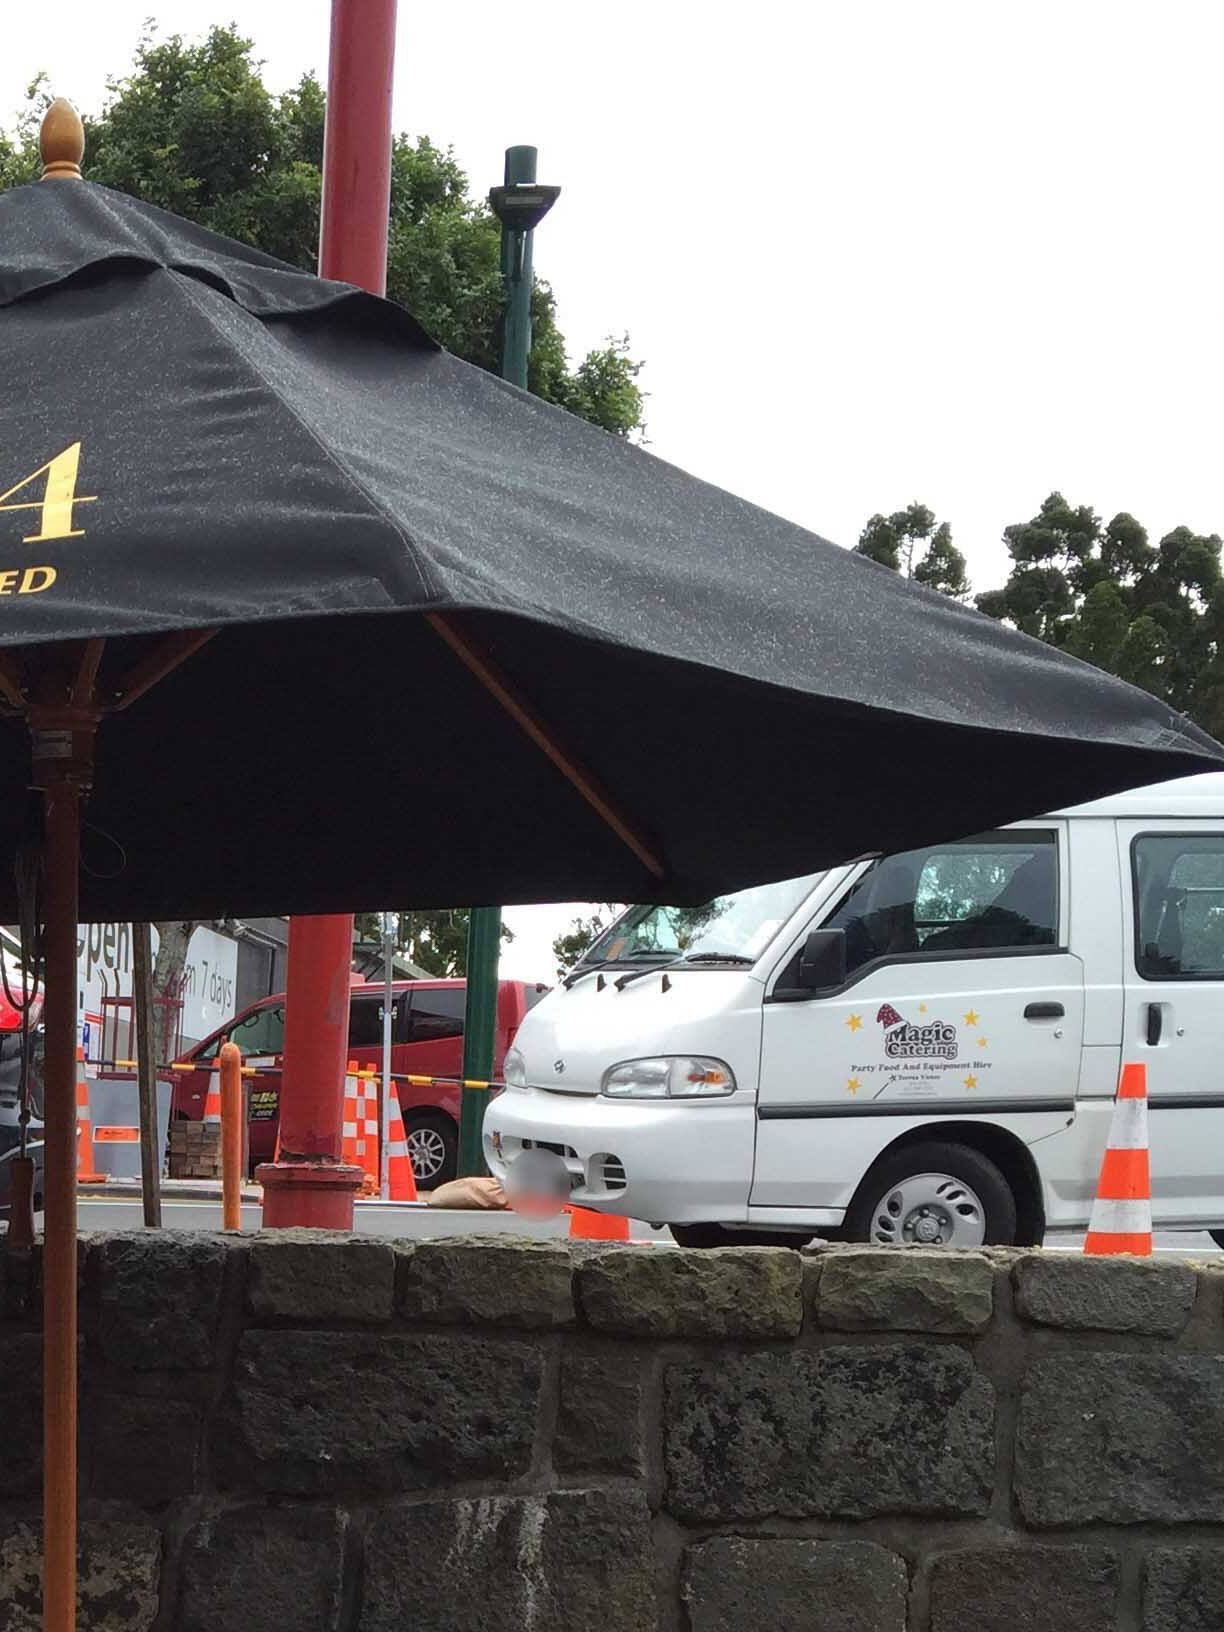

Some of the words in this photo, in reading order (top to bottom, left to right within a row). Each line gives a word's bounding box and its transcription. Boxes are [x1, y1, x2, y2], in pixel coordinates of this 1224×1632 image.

[76, 923, 129, 982] pen
[201, 960, 209, 999] 7
[210, 961, 232, 1016] days
[887, 1022, 954, 1045] Magic
[887, 1042, 957, 1057] Catering
[851, 1064, 875, 1073] Party
[878, 1063, 900, 1072] Food
[902, 1063, 921, 1071] And
[923, 1061, 971, 1072] Equipment
